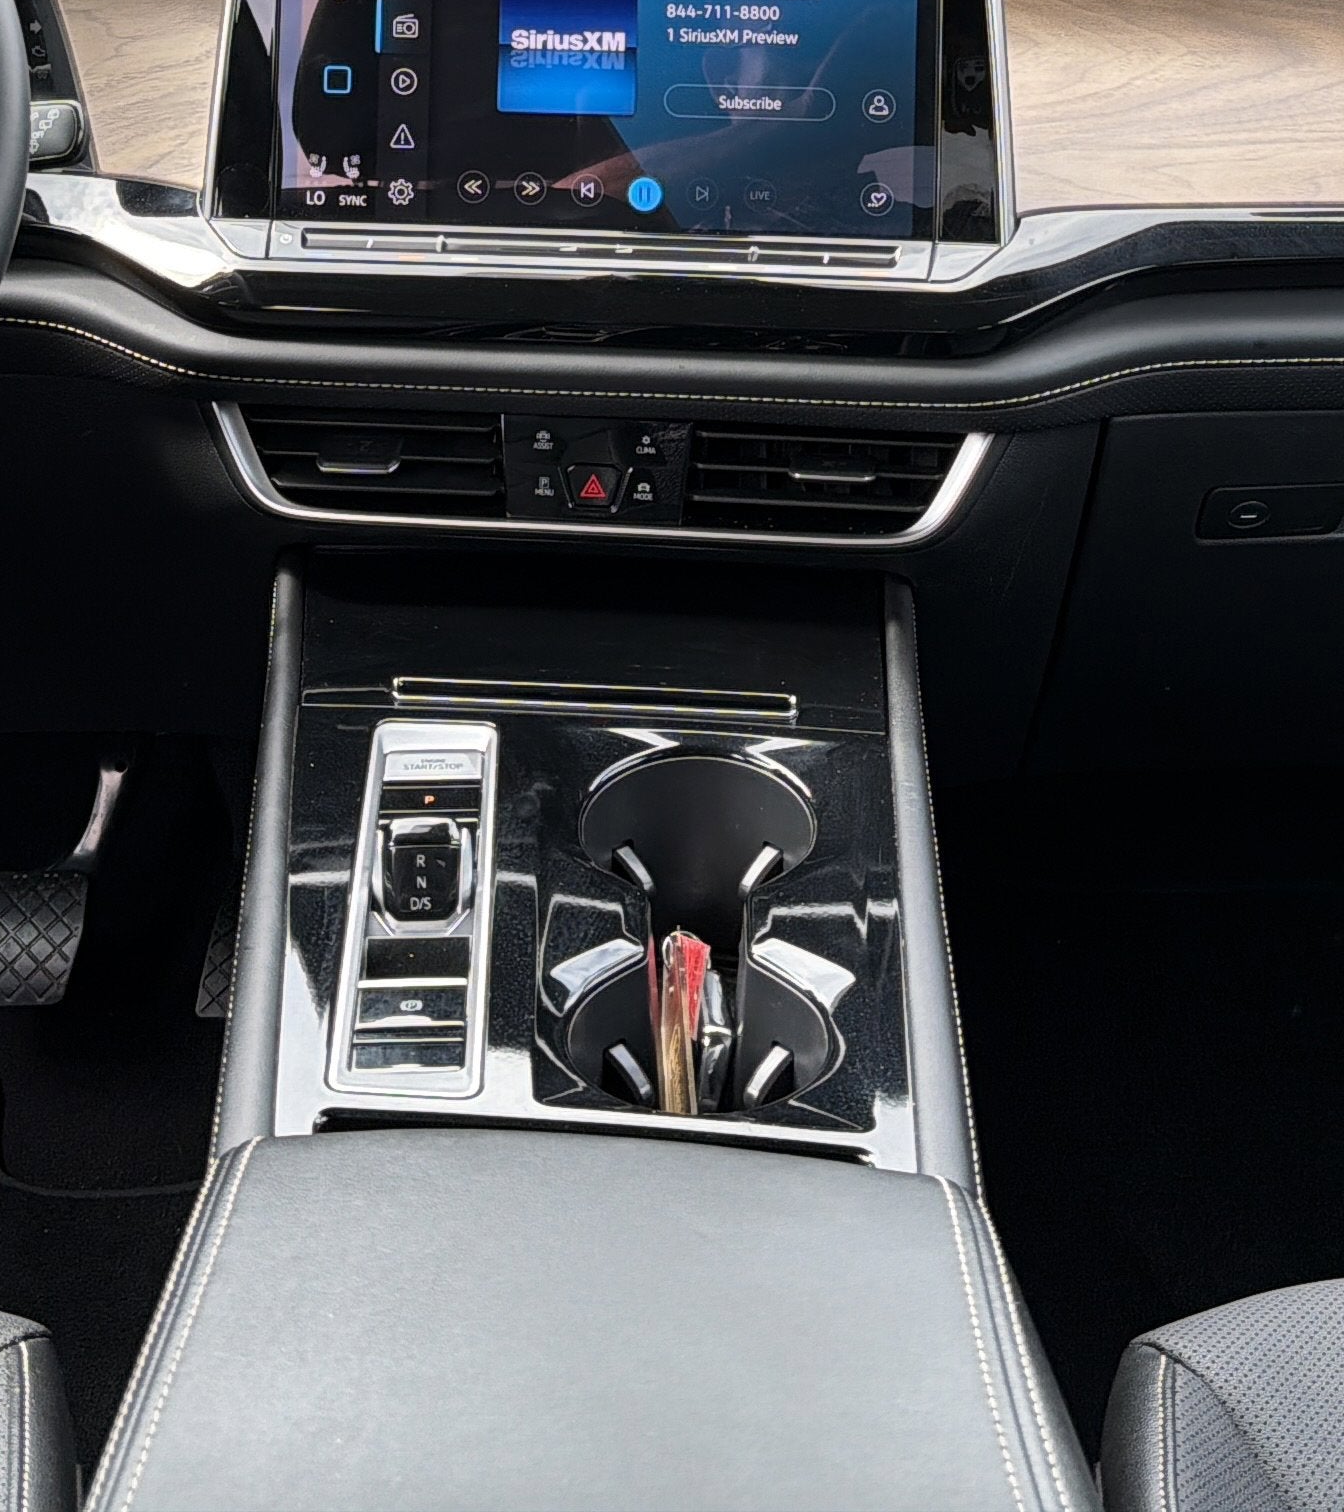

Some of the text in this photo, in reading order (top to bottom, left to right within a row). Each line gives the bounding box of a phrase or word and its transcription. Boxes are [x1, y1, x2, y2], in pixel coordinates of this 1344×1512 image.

[666, 3, 781, 21] 844-711-8800
[510, 29, 626, 52] SiriusXM
[667, 27, 799, 45] 1 SiriusXM Preview
[718, 95, 783, 111] Subscribe
[306, 190, 326, 206] LO
[338, 195, 368, 207] SYNC
[750, 191, 771, 201] LIVE
[532, 441, 554, 451] ASSIST
[635, 446, 657, 455] CLIMA
[534, 489, 555, 497] MENU
[633, 492, 654, 501] MODE
[403, 763, 464, 771] START/STOP
[424, 794, 436, 805] P
[416, 854, 427, 868] R
[416, 875, 427, 889] N
[409, 896, 432, 911] D/S
